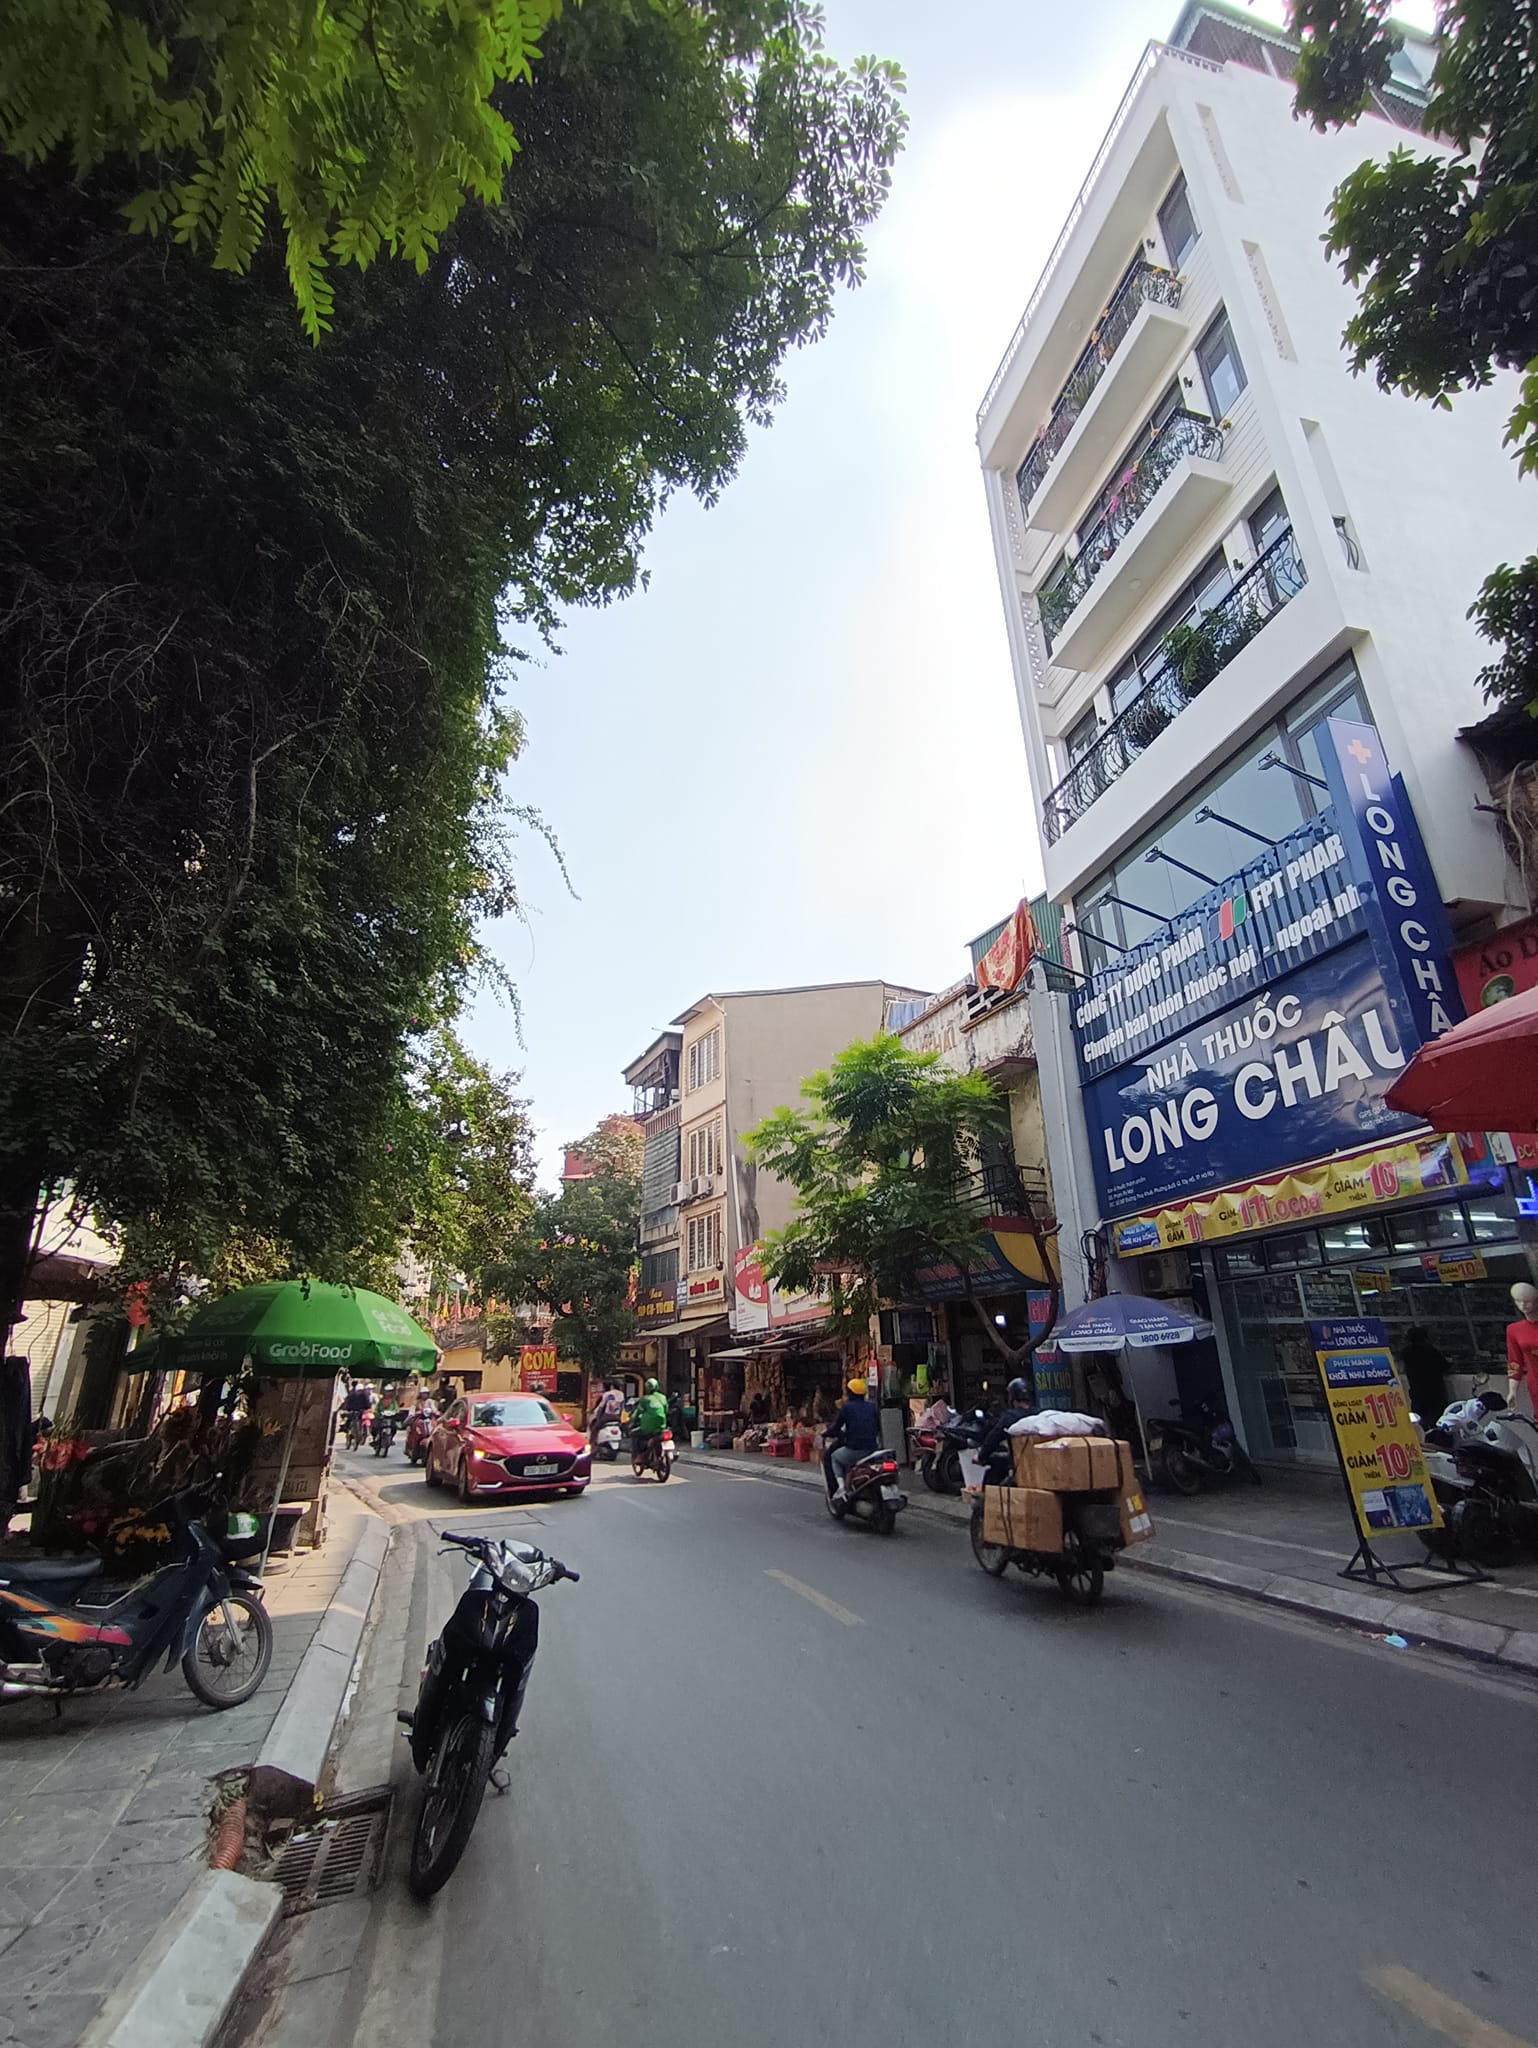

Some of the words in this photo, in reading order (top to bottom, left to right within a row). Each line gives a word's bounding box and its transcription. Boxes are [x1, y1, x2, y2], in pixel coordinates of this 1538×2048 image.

[1360, 774, 1417, 907] LONG
[1076, 995, 1107, 1028] CÔNG
[1106, 981, 1126, 1007] TY
[1251, 871, 1285, 914] FPT
[1124, 1013, 1149, 1040] bán
[1149, 991, 1184, 1026] buôn
[1184, 962, 1228, 1004] thuốc
[1228, 945, 1257, 979] nội
[1276, 898, 1333, 951] ngoại
[1146, 1042, 1199, 1092] NHÀ
[1201, 990, 1302, 1064] THUỐC
[1104, 1088, 1218, 1173] LONG
[1334, 1175, 1364, 1192] GIẢM
[1071, 1328, 1094, 1336] LONG
[1095, 1326, 1116, 1335] CHÂU
[1141, 1334, 1160, 1343] 1800
[1161, 1330, 1180, 1341] 6928
[1333, 1325, 1346, 1334] NHÀ
[1346, 1322, 1367, 1333] THUỐC
[1335, 1336, 1357, 1346] LONG
[1357, 1332, 1378, 1344] CHÂU
[269, 1342, 352, 1359] GrabFood
[1336, 1408, 1367, 1425] GIẢM
[1347, 1451, 1379, 1468] GIẢM
